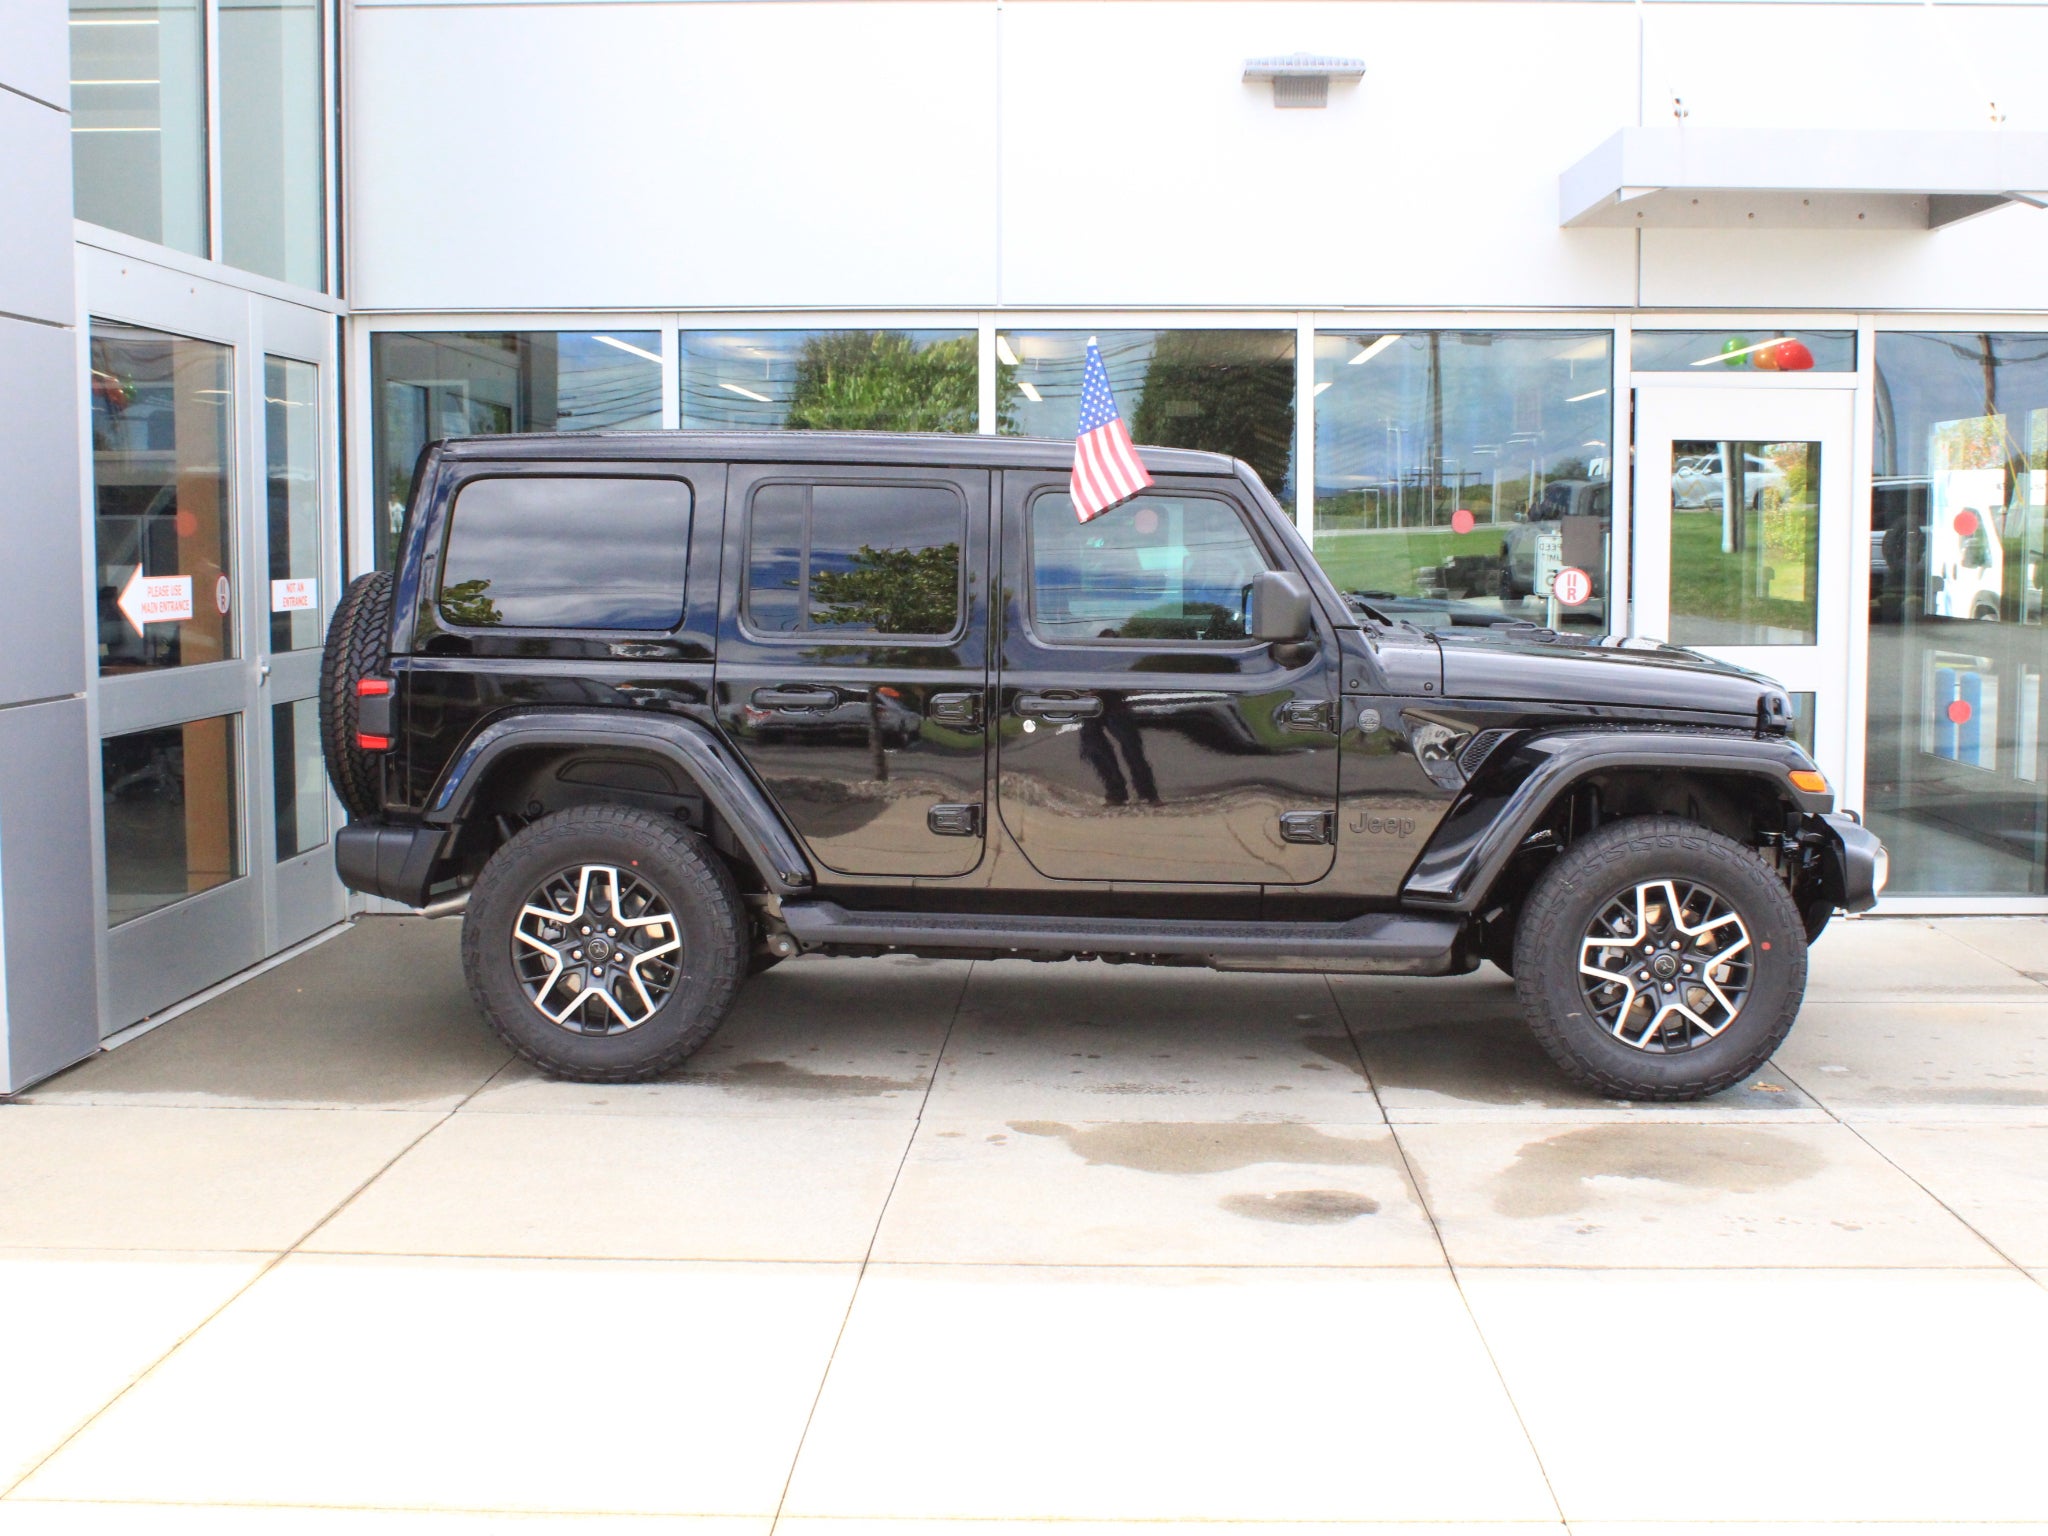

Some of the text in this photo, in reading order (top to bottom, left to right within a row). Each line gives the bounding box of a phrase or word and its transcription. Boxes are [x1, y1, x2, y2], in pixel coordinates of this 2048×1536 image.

[147, 584, 182, 598] PLEASE USE
[1567, 587, 1577, 601] R
[142, 599, 190, 614] MAIN ENTRANCE
[282, 595, 308, 608] ENTRANCE
[1349, 812, 1416, 838] Jeep
